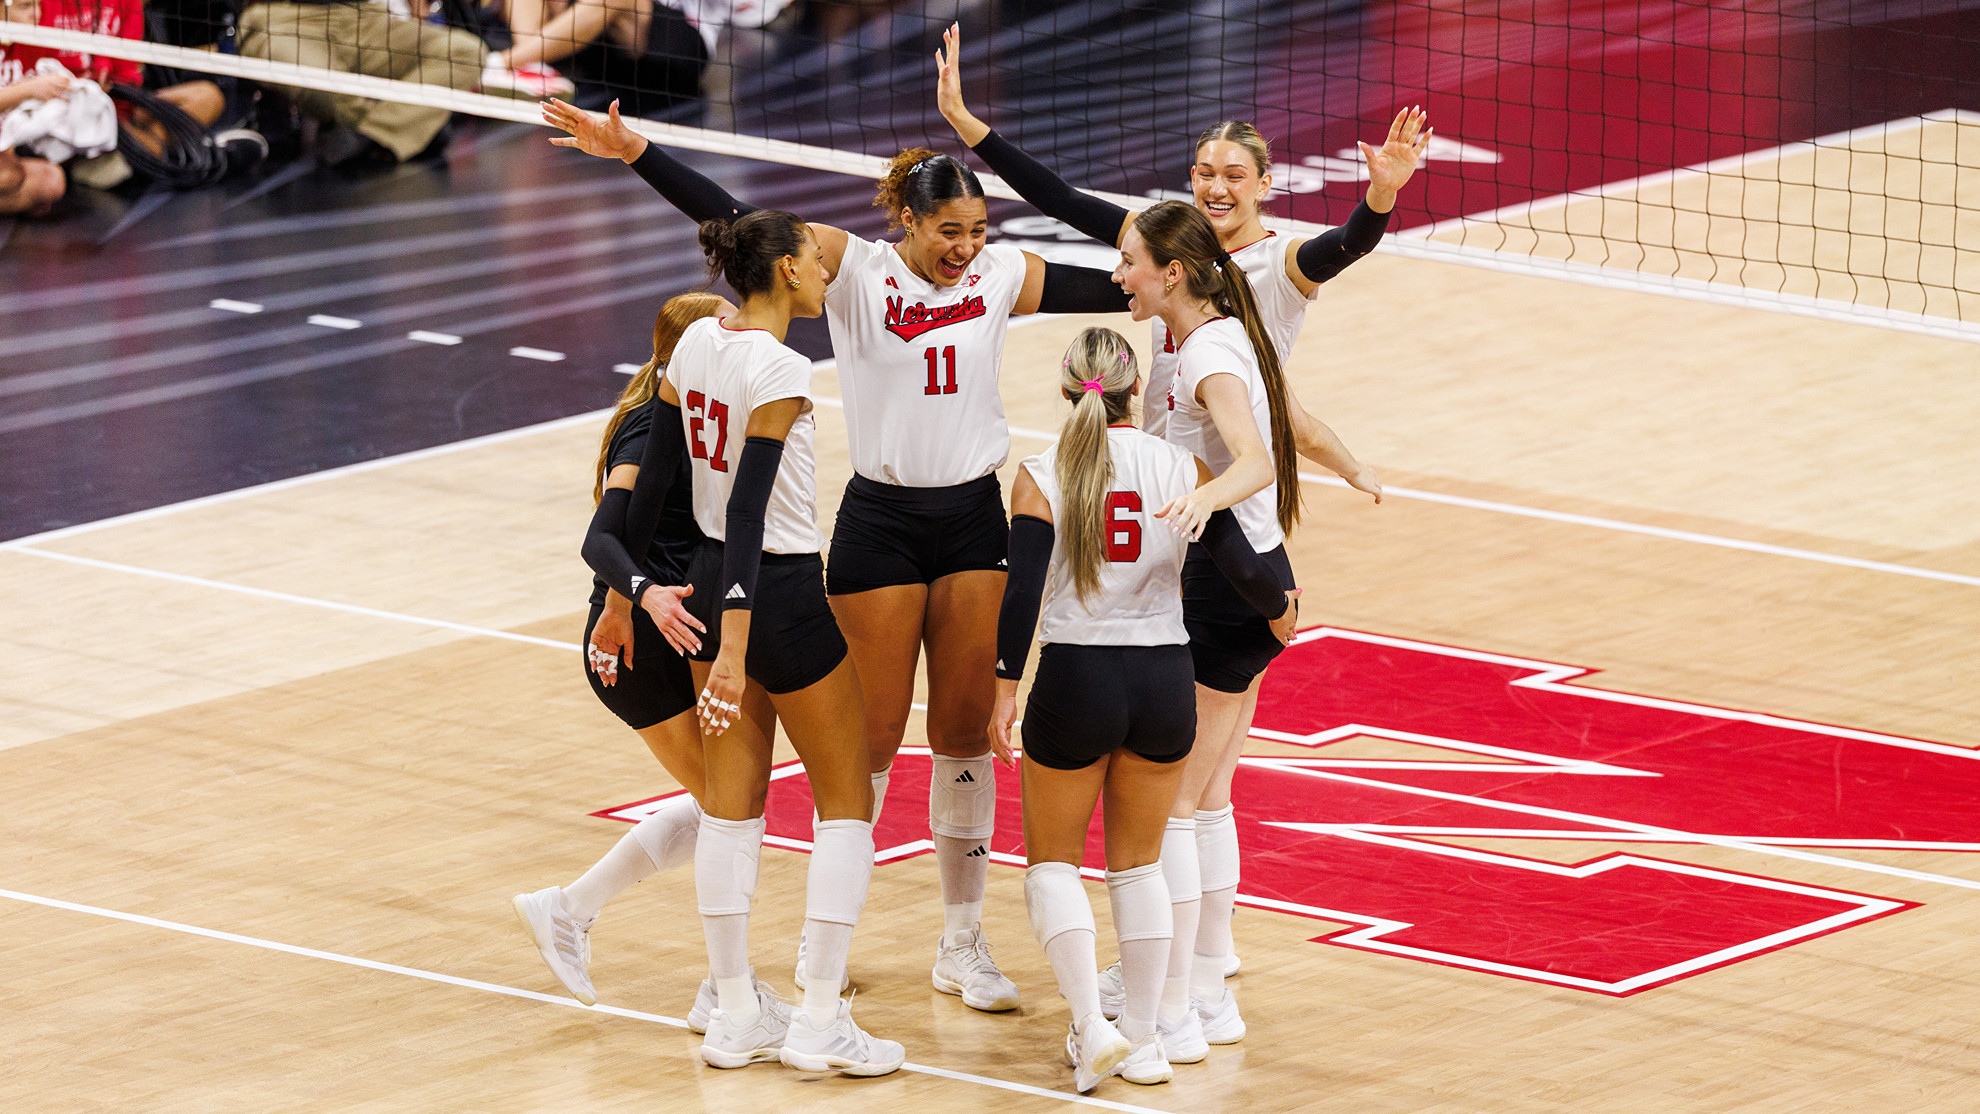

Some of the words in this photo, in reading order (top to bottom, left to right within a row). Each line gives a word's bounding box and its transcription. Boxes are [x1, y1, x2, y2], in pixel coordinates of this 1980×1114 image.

[924, 345, 958, 395] 11
[686, 389, 728, 473] 27
[1101, 491, 1142, 562] 6
